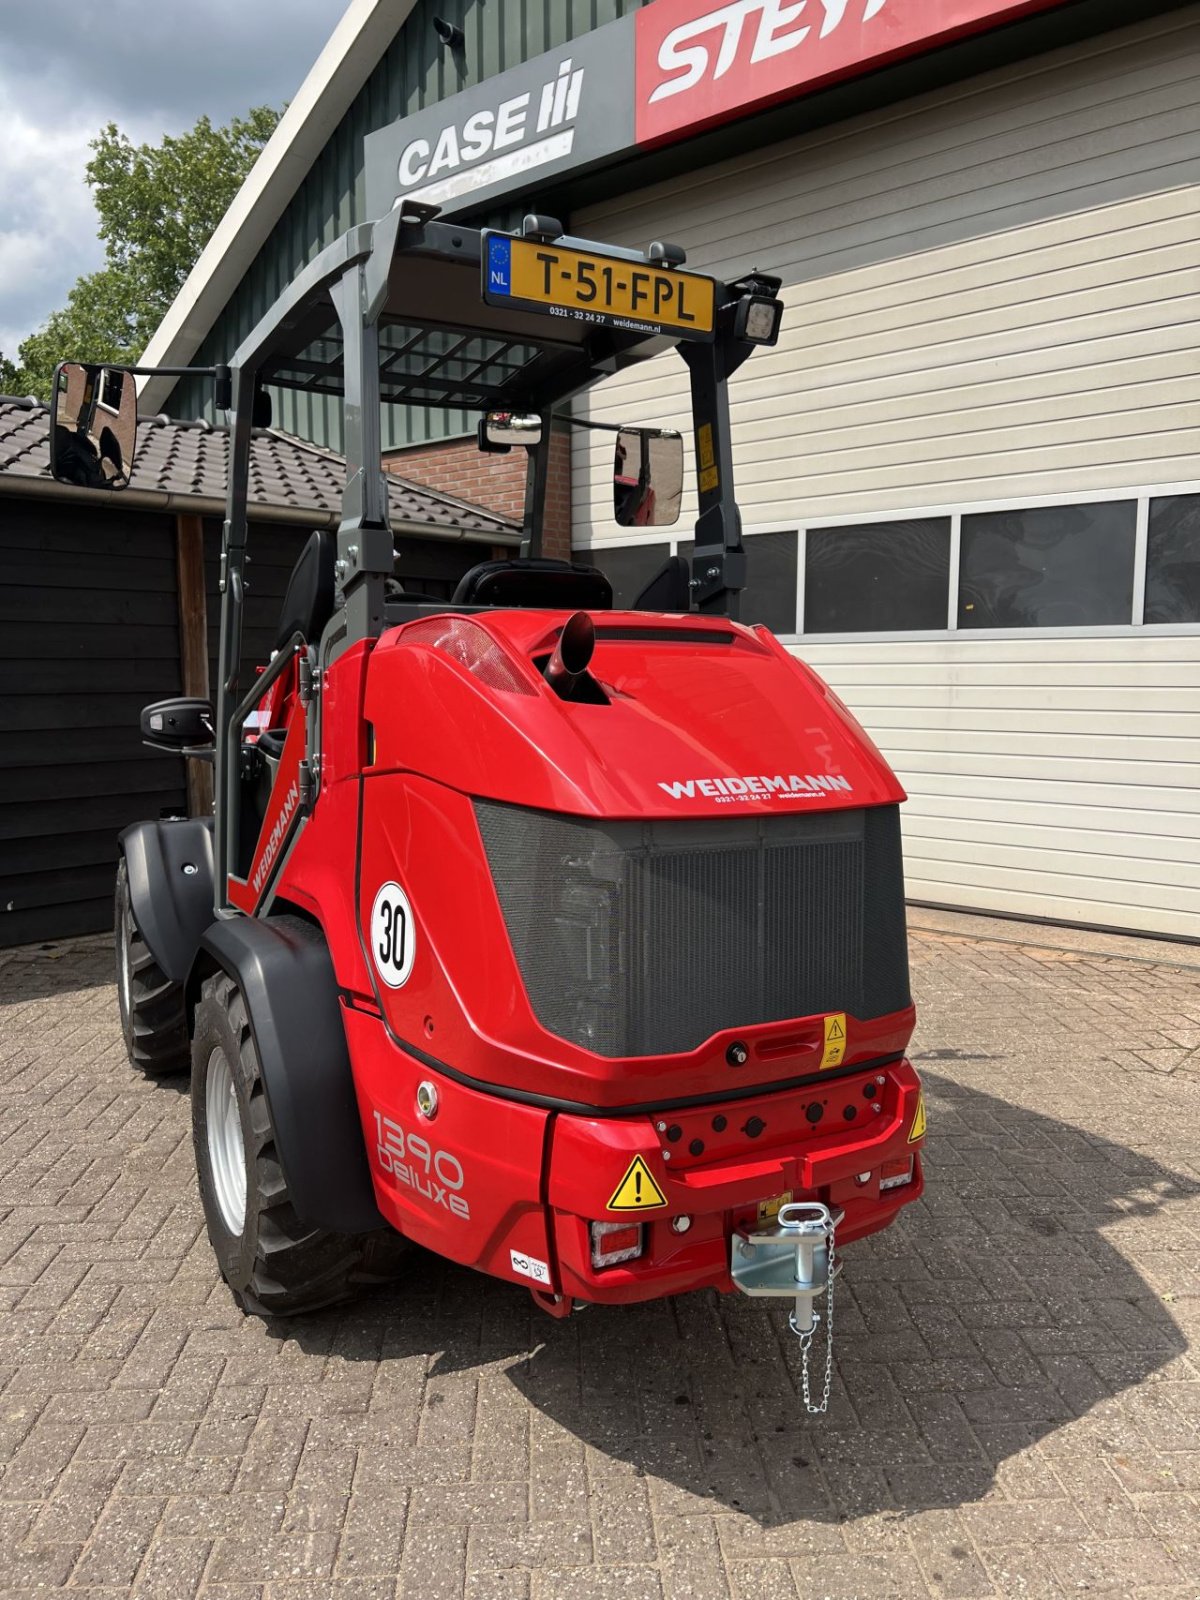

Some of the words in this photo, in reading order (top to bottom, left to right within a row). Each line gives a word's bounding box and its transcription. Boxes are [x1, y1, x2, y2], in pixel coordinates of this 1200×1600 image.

[648, 0, 886, 104] STEY
[398, 92, 530, 186] CASE
[491, 271, 507, 286] NL
[537, 253, 695, 321] T-51-FPL
[549, 306, 568, 317] 0321
[574, 310, 584, 320] 32
[585, 312, 595, 321] 24
[596, 314, 605, 323] 27
[613, 319, 660, 333] weidemann.nl
[657, 775, 853, 799] WEIDEMANN
[778, 791, 826, 799] weidemann.nl
[252, 781, 299, 893] WEIDEMANN
[380, 900, 405, 970] 30
[373, 1110, 464, 1190] 1390
[377, 1143, 470, 1220] Deluxe
